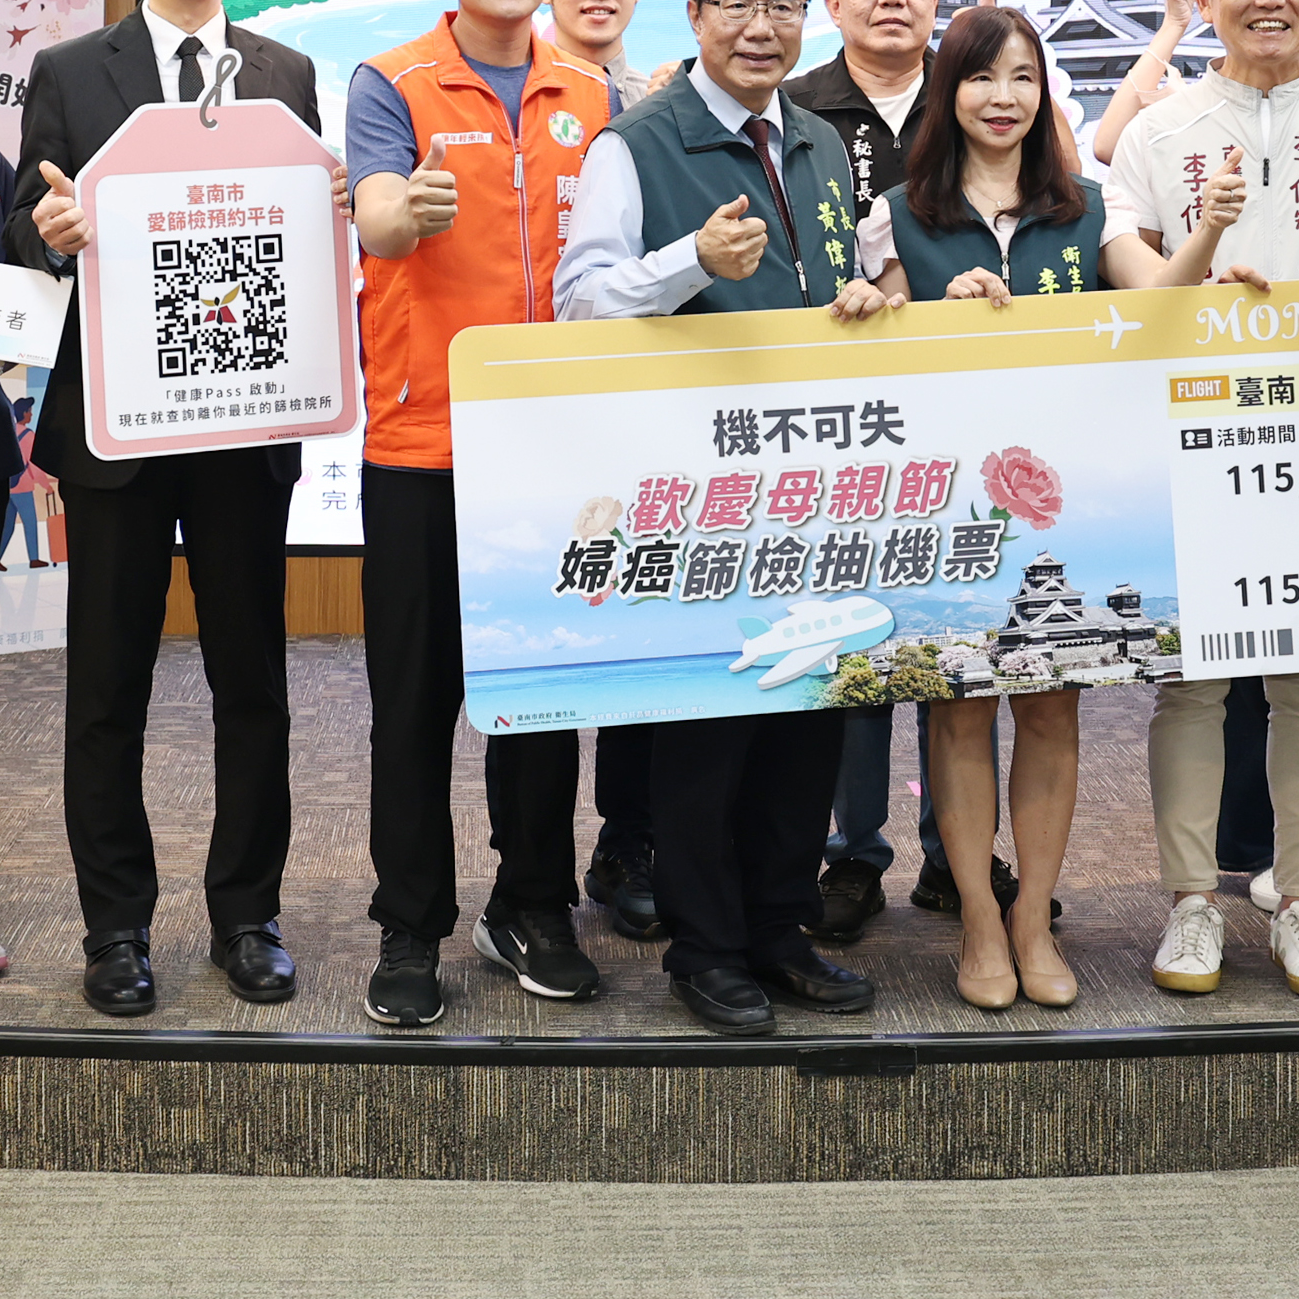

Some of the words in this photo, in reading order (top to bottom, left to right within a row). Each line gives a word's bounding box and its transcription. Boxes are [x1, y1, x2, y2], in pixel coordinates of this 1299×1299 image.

[852, 139, 875, 202] 秘書長
[186, 182, 245, 205] 臺南市
[147, 204, 286, 233] 愛篩檢預約平台
[556, 174, 580, 258] 陳皇
[1176, 380, 1222, 399] FLIGHT
[1235, 374, 1297, 408] 臺南
[118, 395, 333, 428] 現在就查詢離你最近的篩檢院所
[712, 399, 907, 458] 機不可失
[1216, 424, 1297, 448] 活動期間
[632, 458, 953, 536] 歡慶母親節
[556, 522, 1003, 598] 婦癌篩檢抽機票
